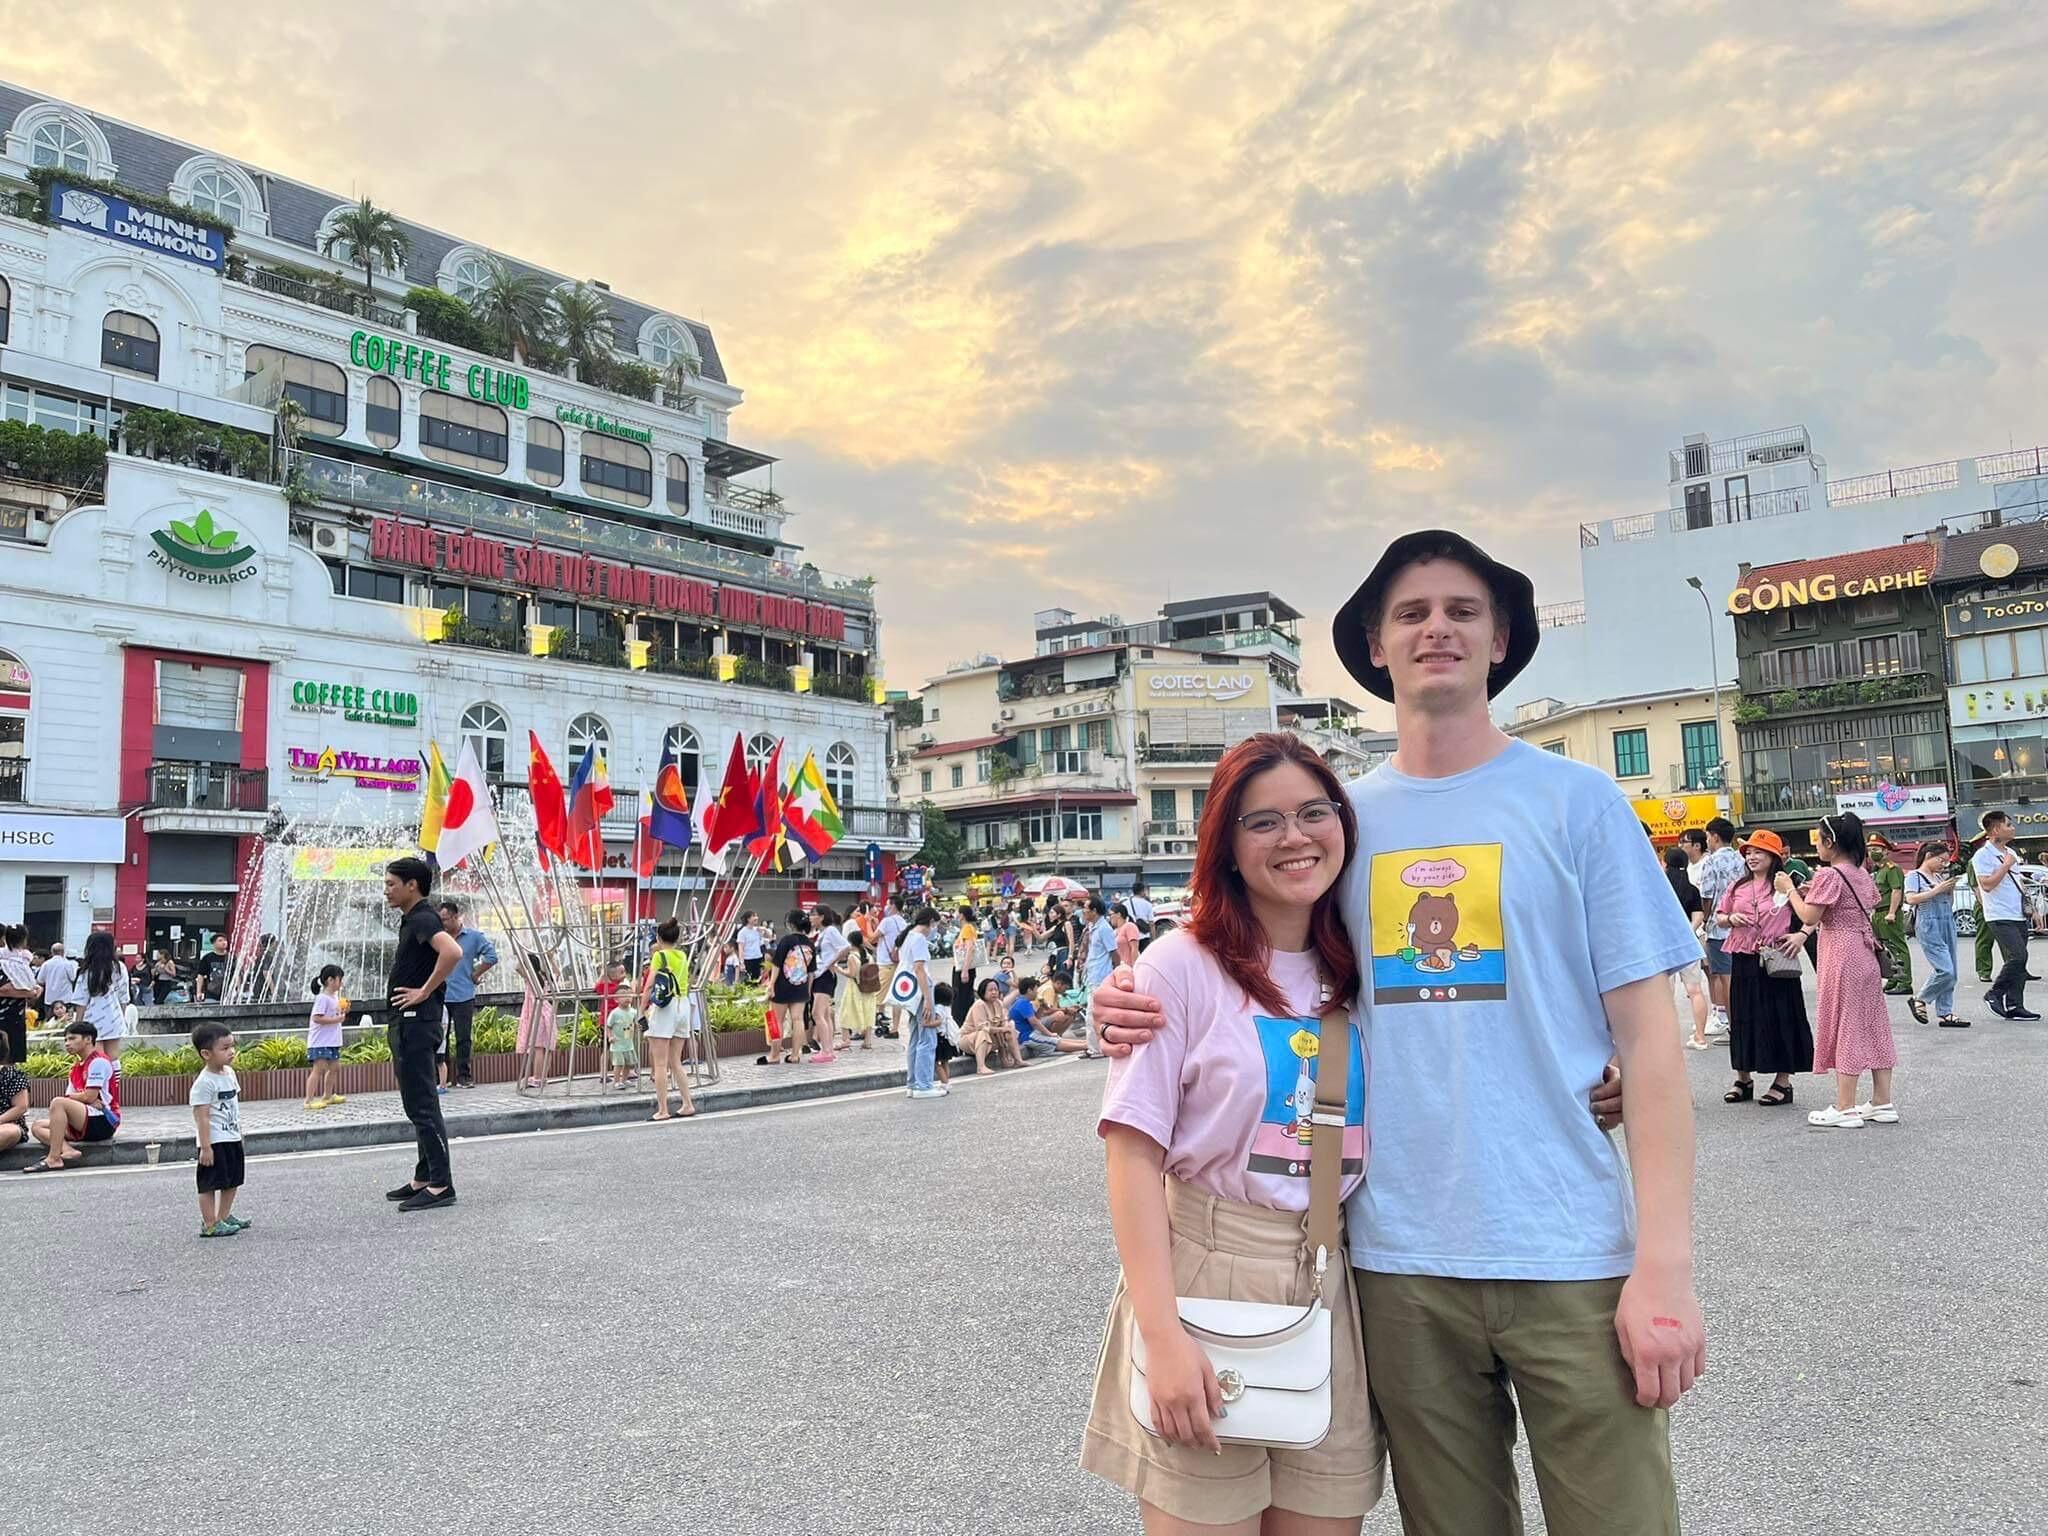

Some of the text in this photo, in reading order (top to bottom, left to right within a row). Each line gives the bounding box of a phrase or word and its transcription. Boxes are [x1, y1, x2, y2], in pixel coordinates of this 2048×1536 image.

[114, 220, 217, 261] DIAMOND
[128, 206, 207, 243] MINH
[351, 331, 529, 410] COFFEE CLUB
[597, 415, 653, 443] Restaurant
[147, 549, 258, 585] PHYTOPHARCO
[607, 563, 652, 604] NAM
[1727, 577, 1838, 615] CỘNG
[293, 681, 417, 715] COFFEE CLUB
[309, 776, 329, 785] Floor
[2, 830, 55, 846] HSBC
[1411, 874, 1421, 882] by
[1428, 865, 1452, 873] always
